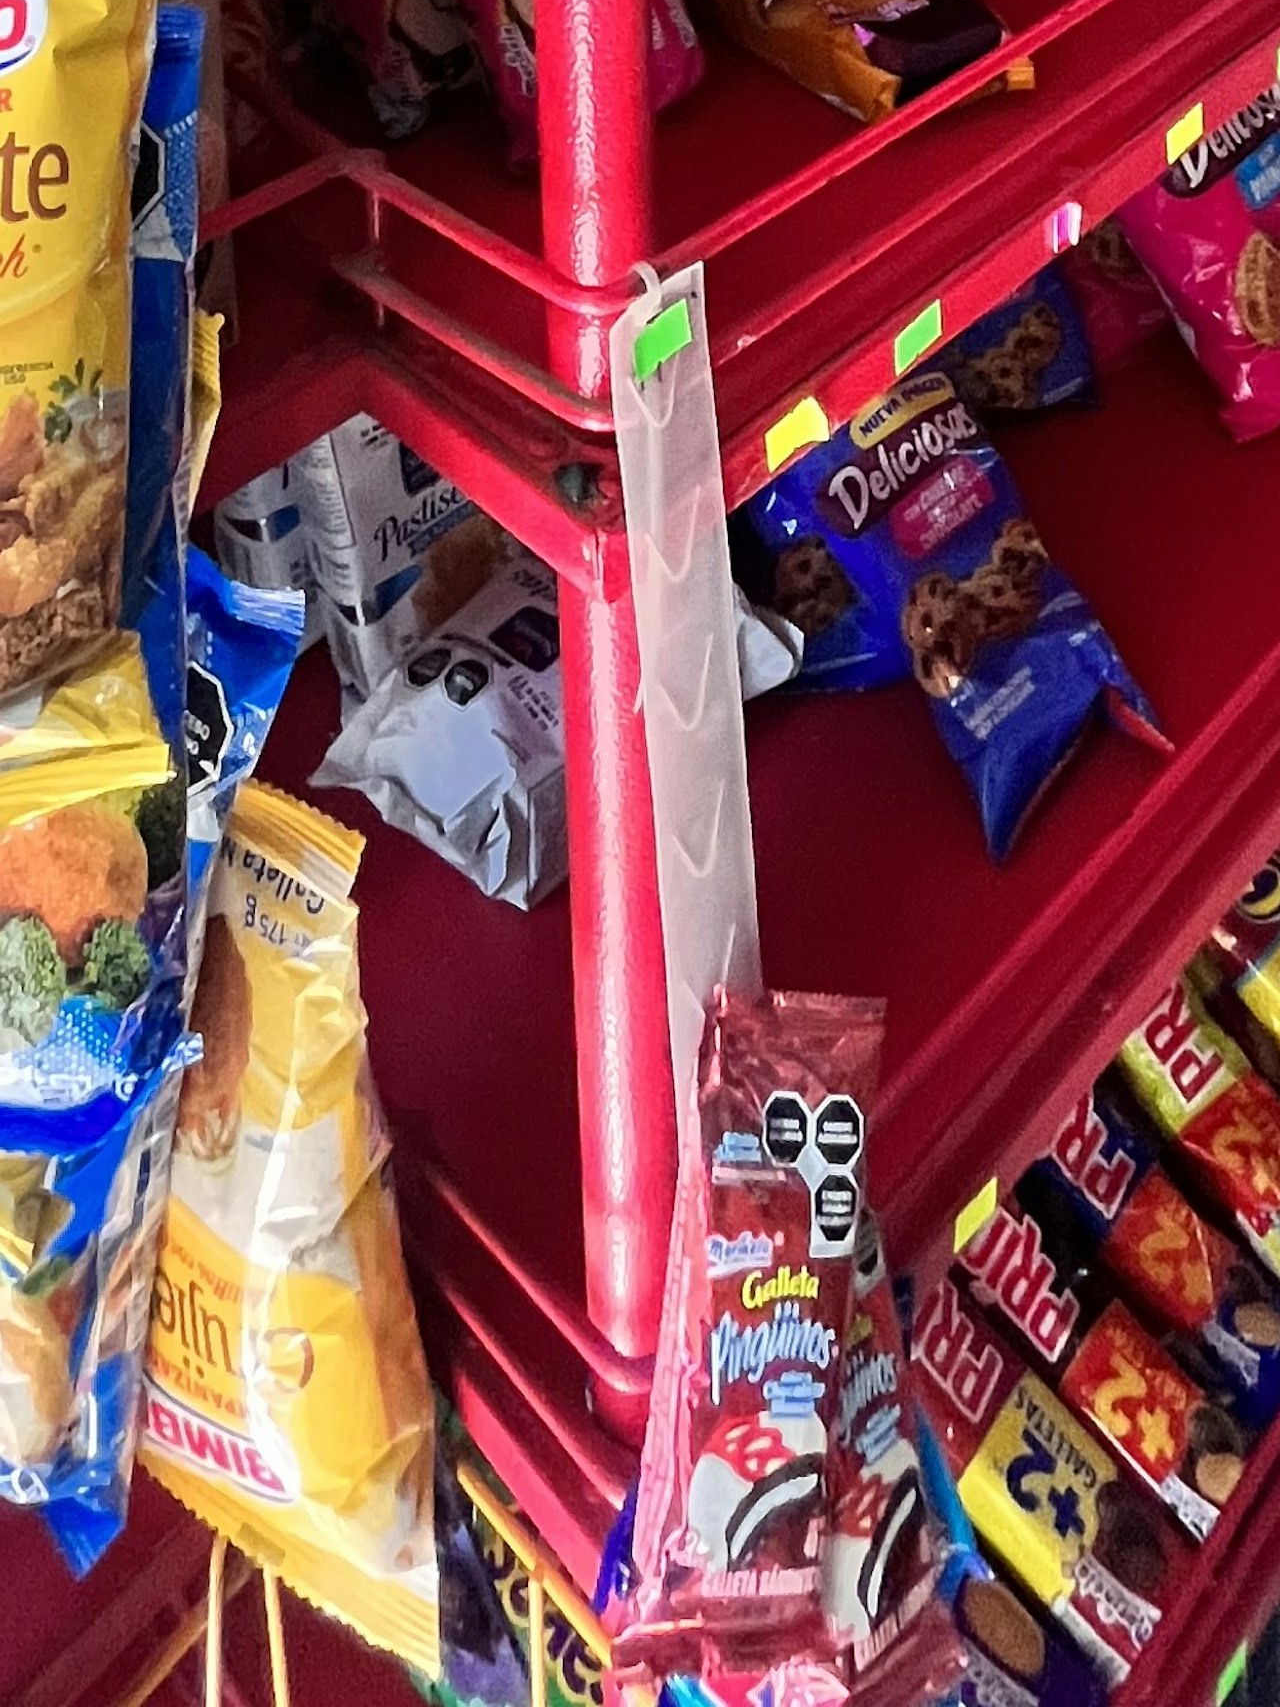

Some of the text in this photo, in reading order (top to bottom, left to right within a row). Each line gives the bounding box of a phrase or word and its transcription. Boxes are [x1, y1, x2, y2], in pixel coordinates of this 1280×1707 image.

[828, 402, 979, 530] Deliciosas
[741, 1264, 820, 1309] Galleta
[710, 1301, 838, 1408] Pingüinos
